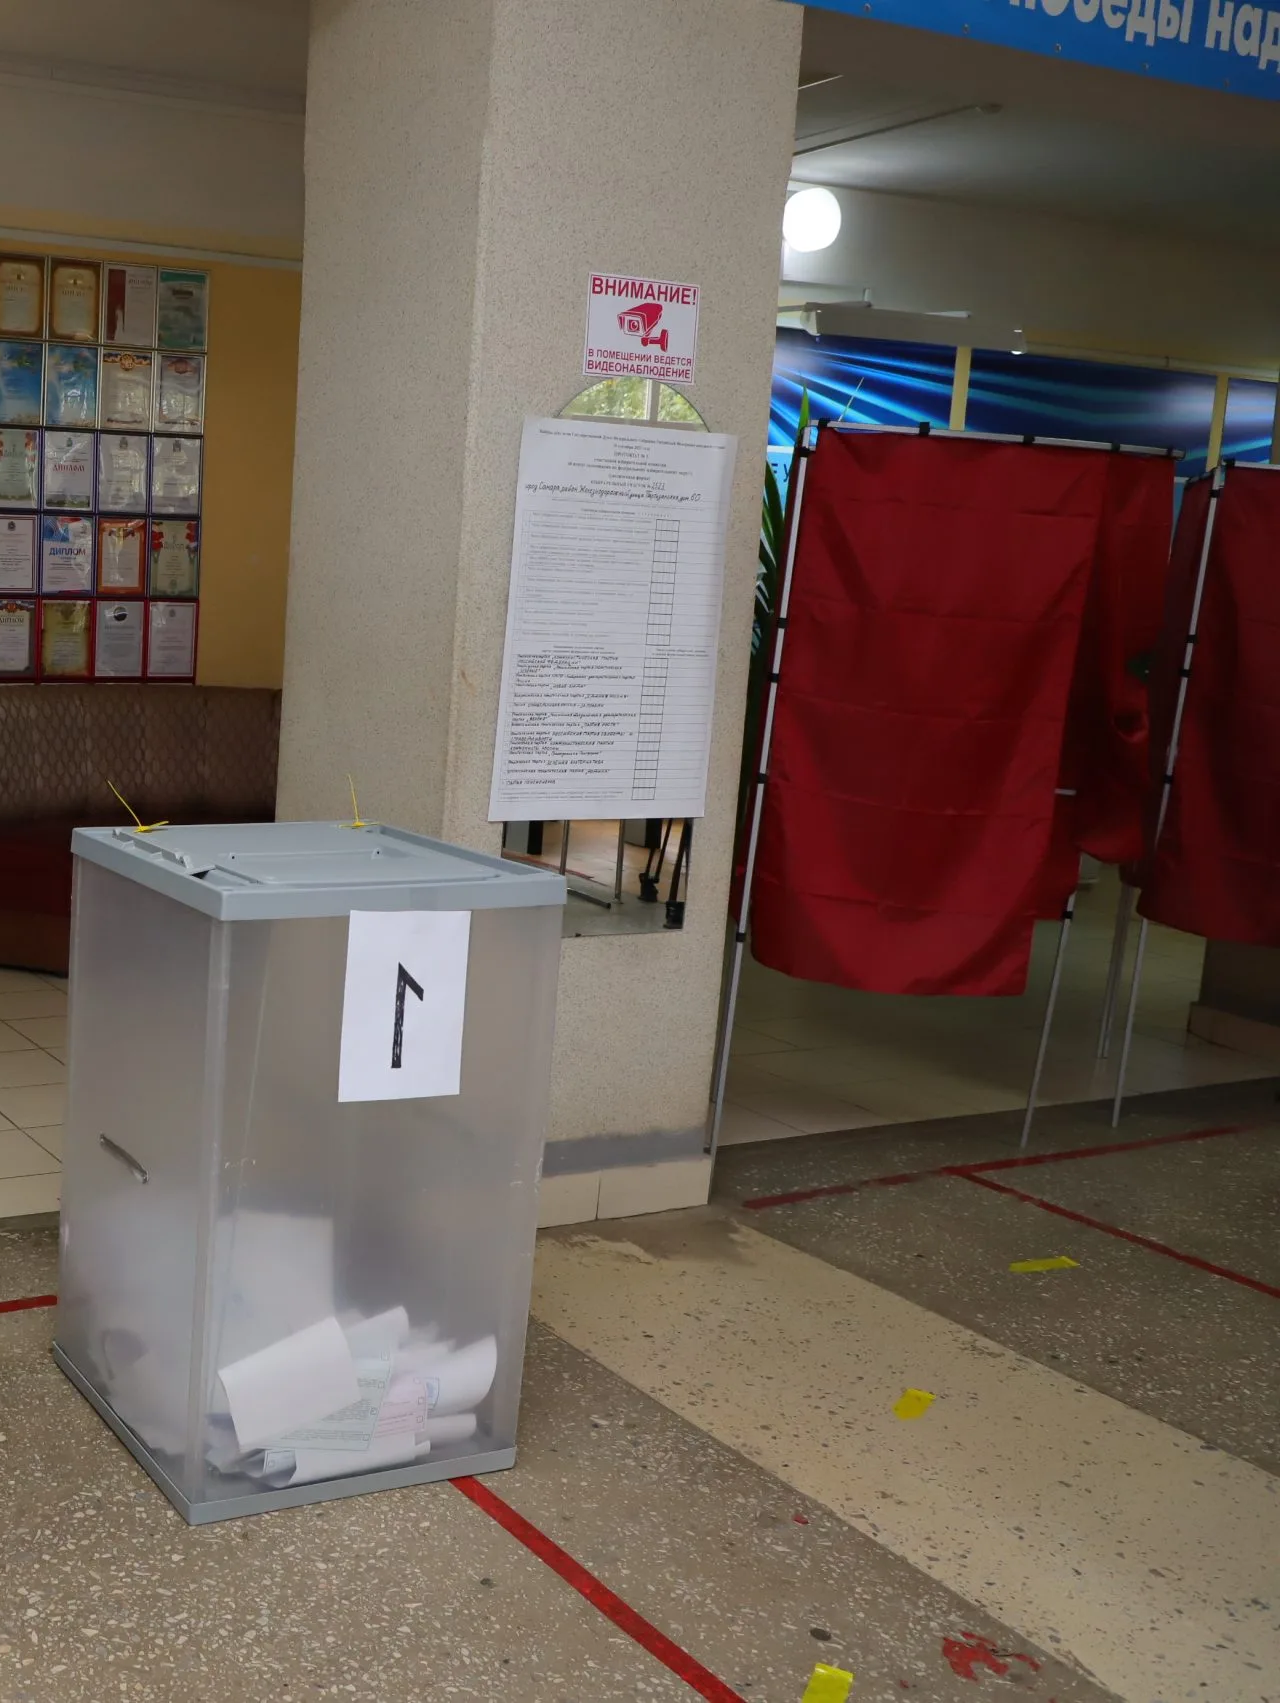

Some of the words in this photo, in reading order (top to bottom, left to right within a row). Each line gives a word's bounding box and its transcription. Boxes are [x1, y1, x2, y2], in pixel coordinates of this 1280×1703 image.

[1009, 0, 1194, 46] еды
[591, 276, 697, 306] ВНИМАНИЕ!
[588, 348, 594, 357] В
[596, 350, 652, 363] ПОМЕЩЕНИИ
[654, 354, 692, 367] ВЕДЕТСЯ
[587, 359, 691, 379] ВИДЕОНАБЛЮДЕНИЕ
[49, 547, 86, 556] ДИПЛОМ
